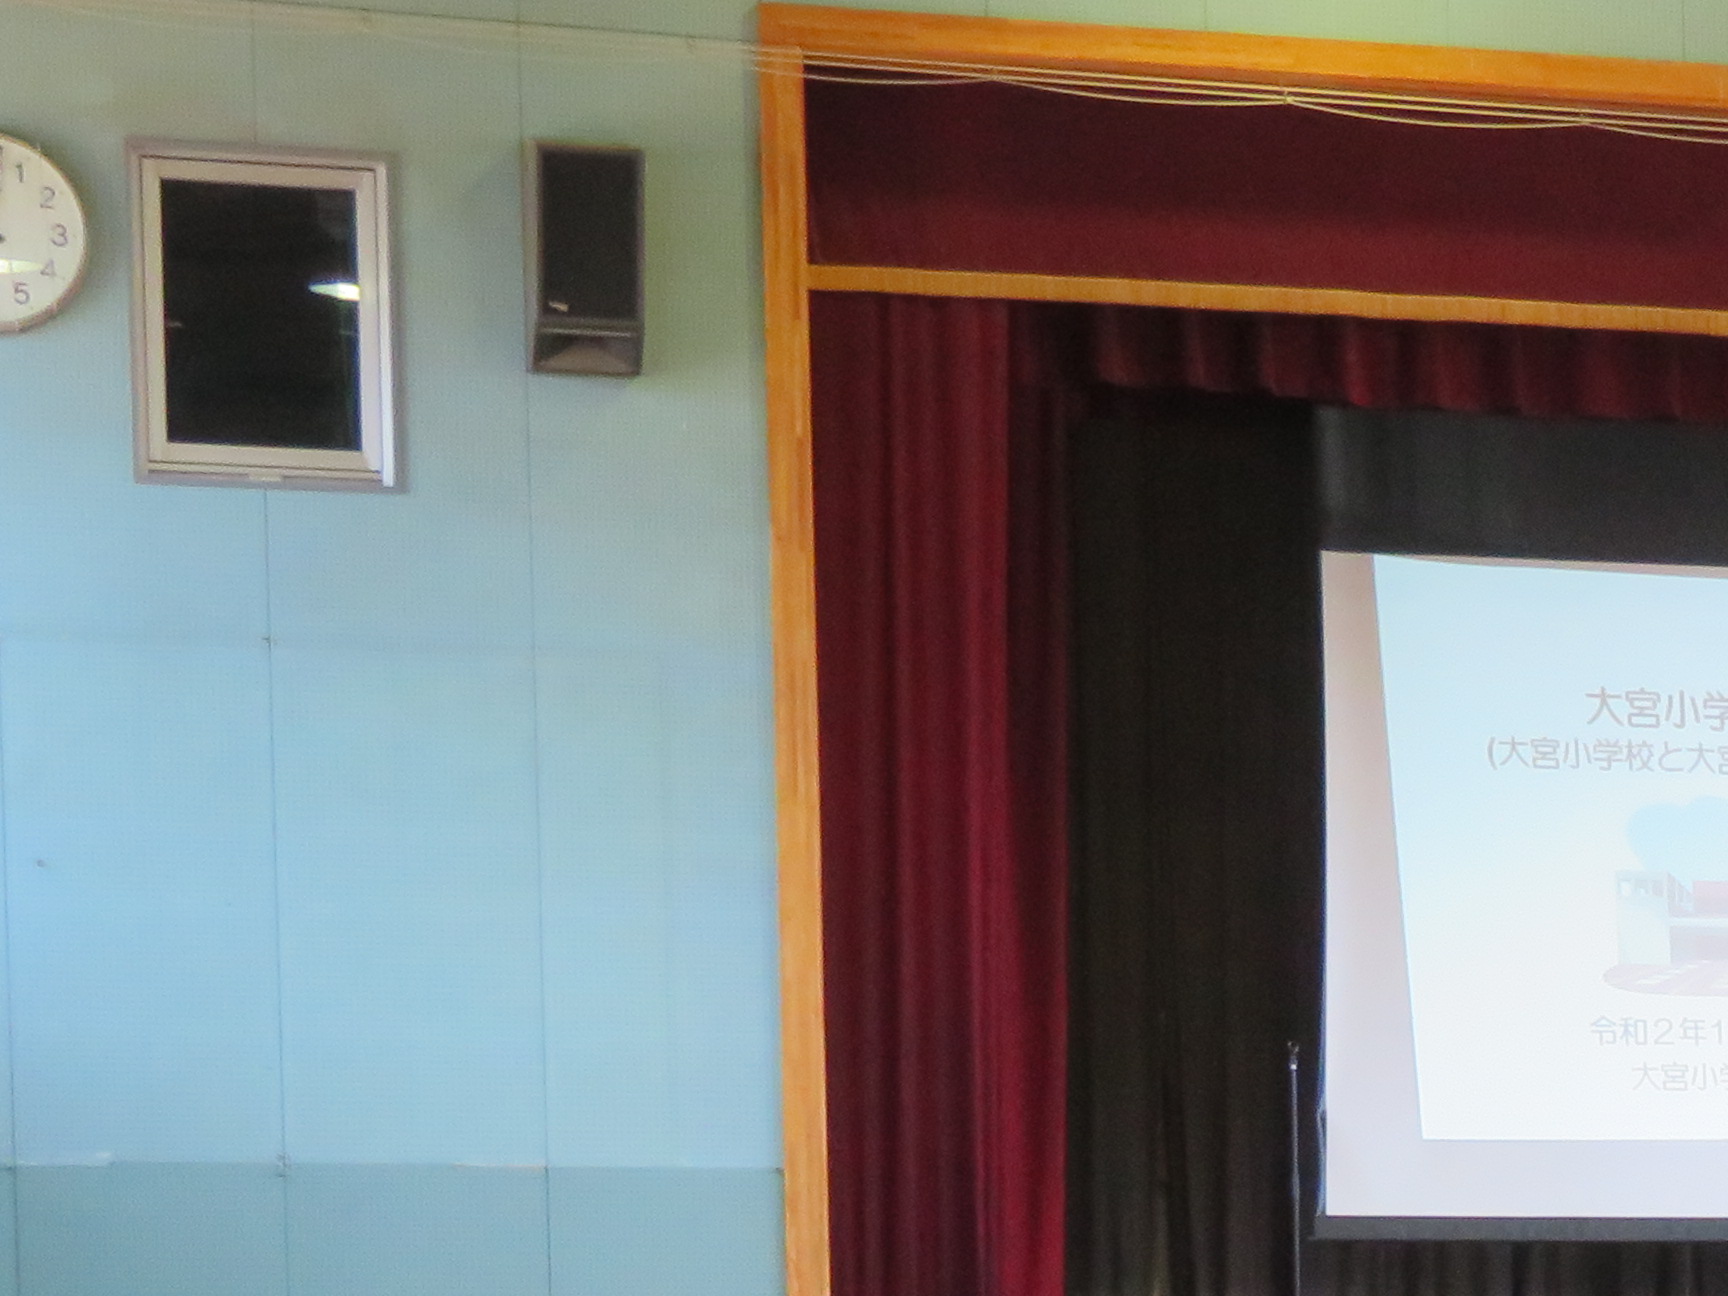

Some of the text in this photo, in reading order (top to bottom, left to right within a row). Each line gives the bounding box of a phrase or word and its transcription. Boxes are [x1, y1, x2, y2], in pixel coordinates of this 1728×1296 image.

[15, 163, 24, 183] 1
[40, 187, 56, 209] 2
[51, 224, 68, 247] 3
[14, 283, 30, 304] 5
